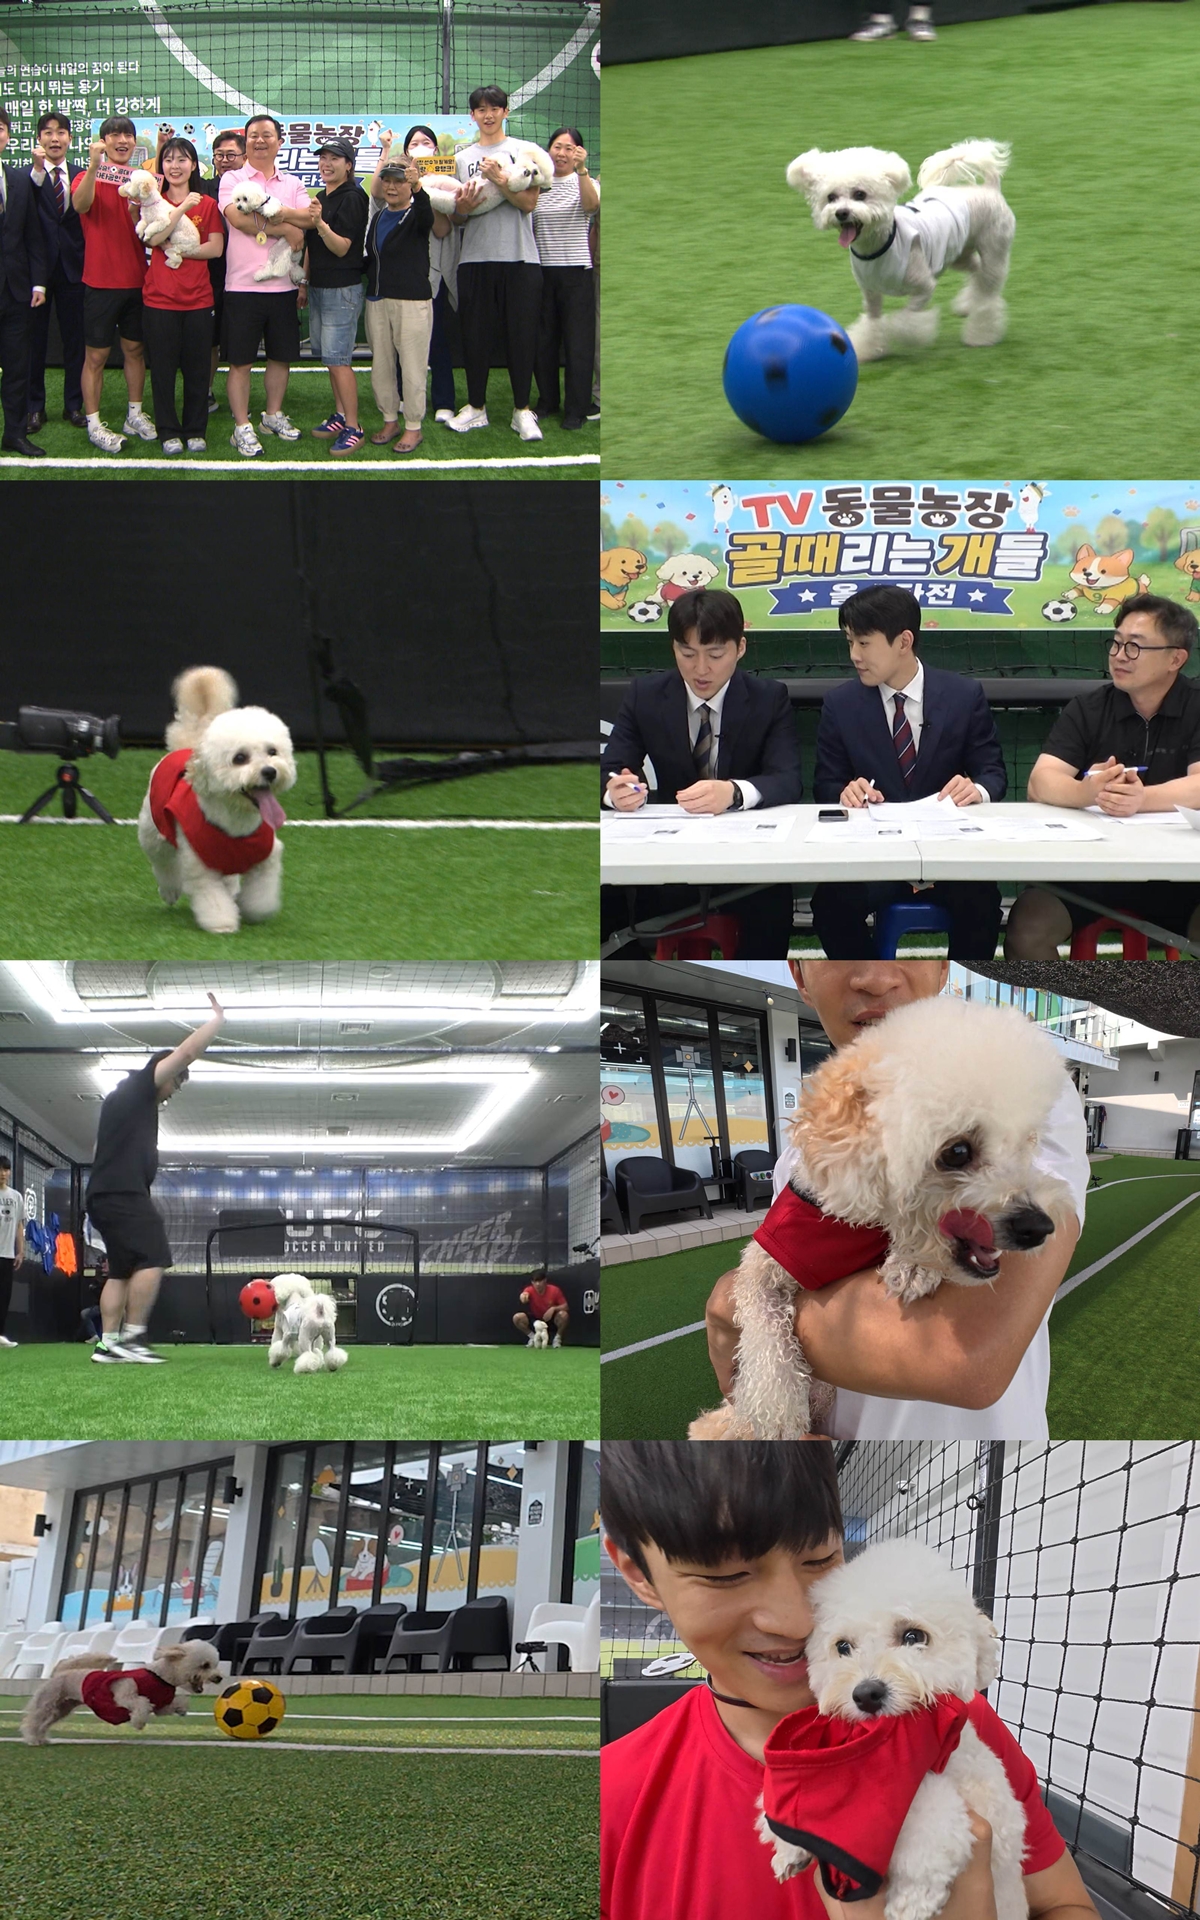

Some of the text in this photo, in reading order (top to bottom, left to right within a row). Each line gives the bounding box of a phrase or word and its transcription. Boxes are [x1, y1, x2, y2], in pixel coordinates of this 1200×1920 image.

[20, 63, 52, 77] 연습이
[55, 61, 88, 75] 내일의
[92, 61, 113, 75] 꿈이
[117, 60, 139, 74] 된다
[0, 79, 104, 96] 도 다시 뛰는 용기
[5, 96, 160, 117] 매일 한 발짝, 더 강하게
[742, 486, 1014, 528] TV 동물농장
[285, 1209, 384, 1239] UFC
[284, 1240, 385, 1252] OCCER UNIED
